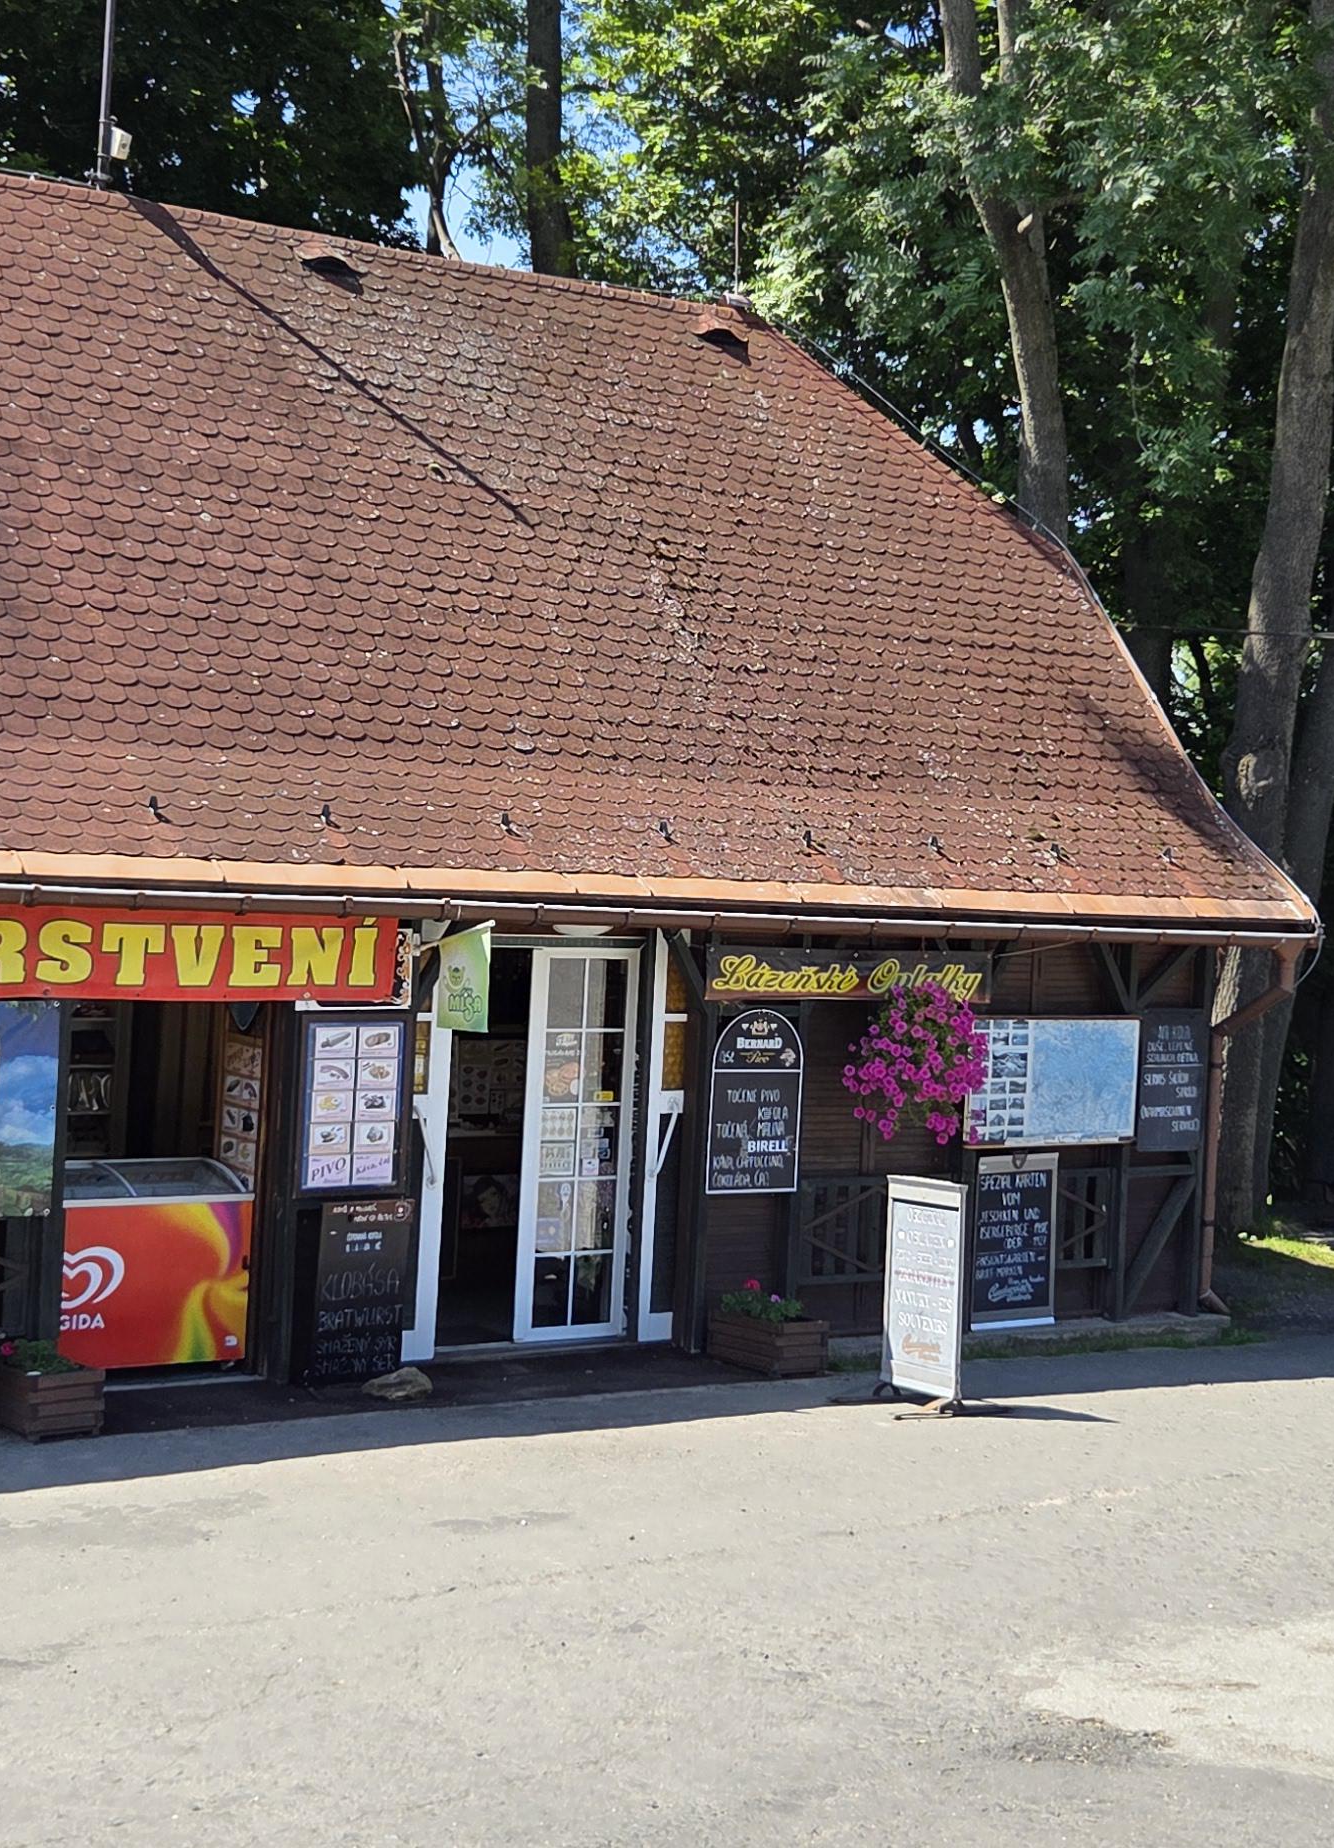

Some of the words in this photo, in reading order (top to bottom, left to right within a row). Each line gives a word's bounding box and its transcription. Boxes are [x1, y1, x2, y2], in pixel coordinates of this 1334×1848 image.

[713, 954, 859, 992] Lázeňské
[736, 1036, 783, 1049] BERNARD
[761, 1089, 780, 1102] PIVO
[748, 1140, 788, 1153] BIRELL
[311, 1157, 347, 1182] PIVO
[321, 1262, 400, 1301] KLOBÁSA
